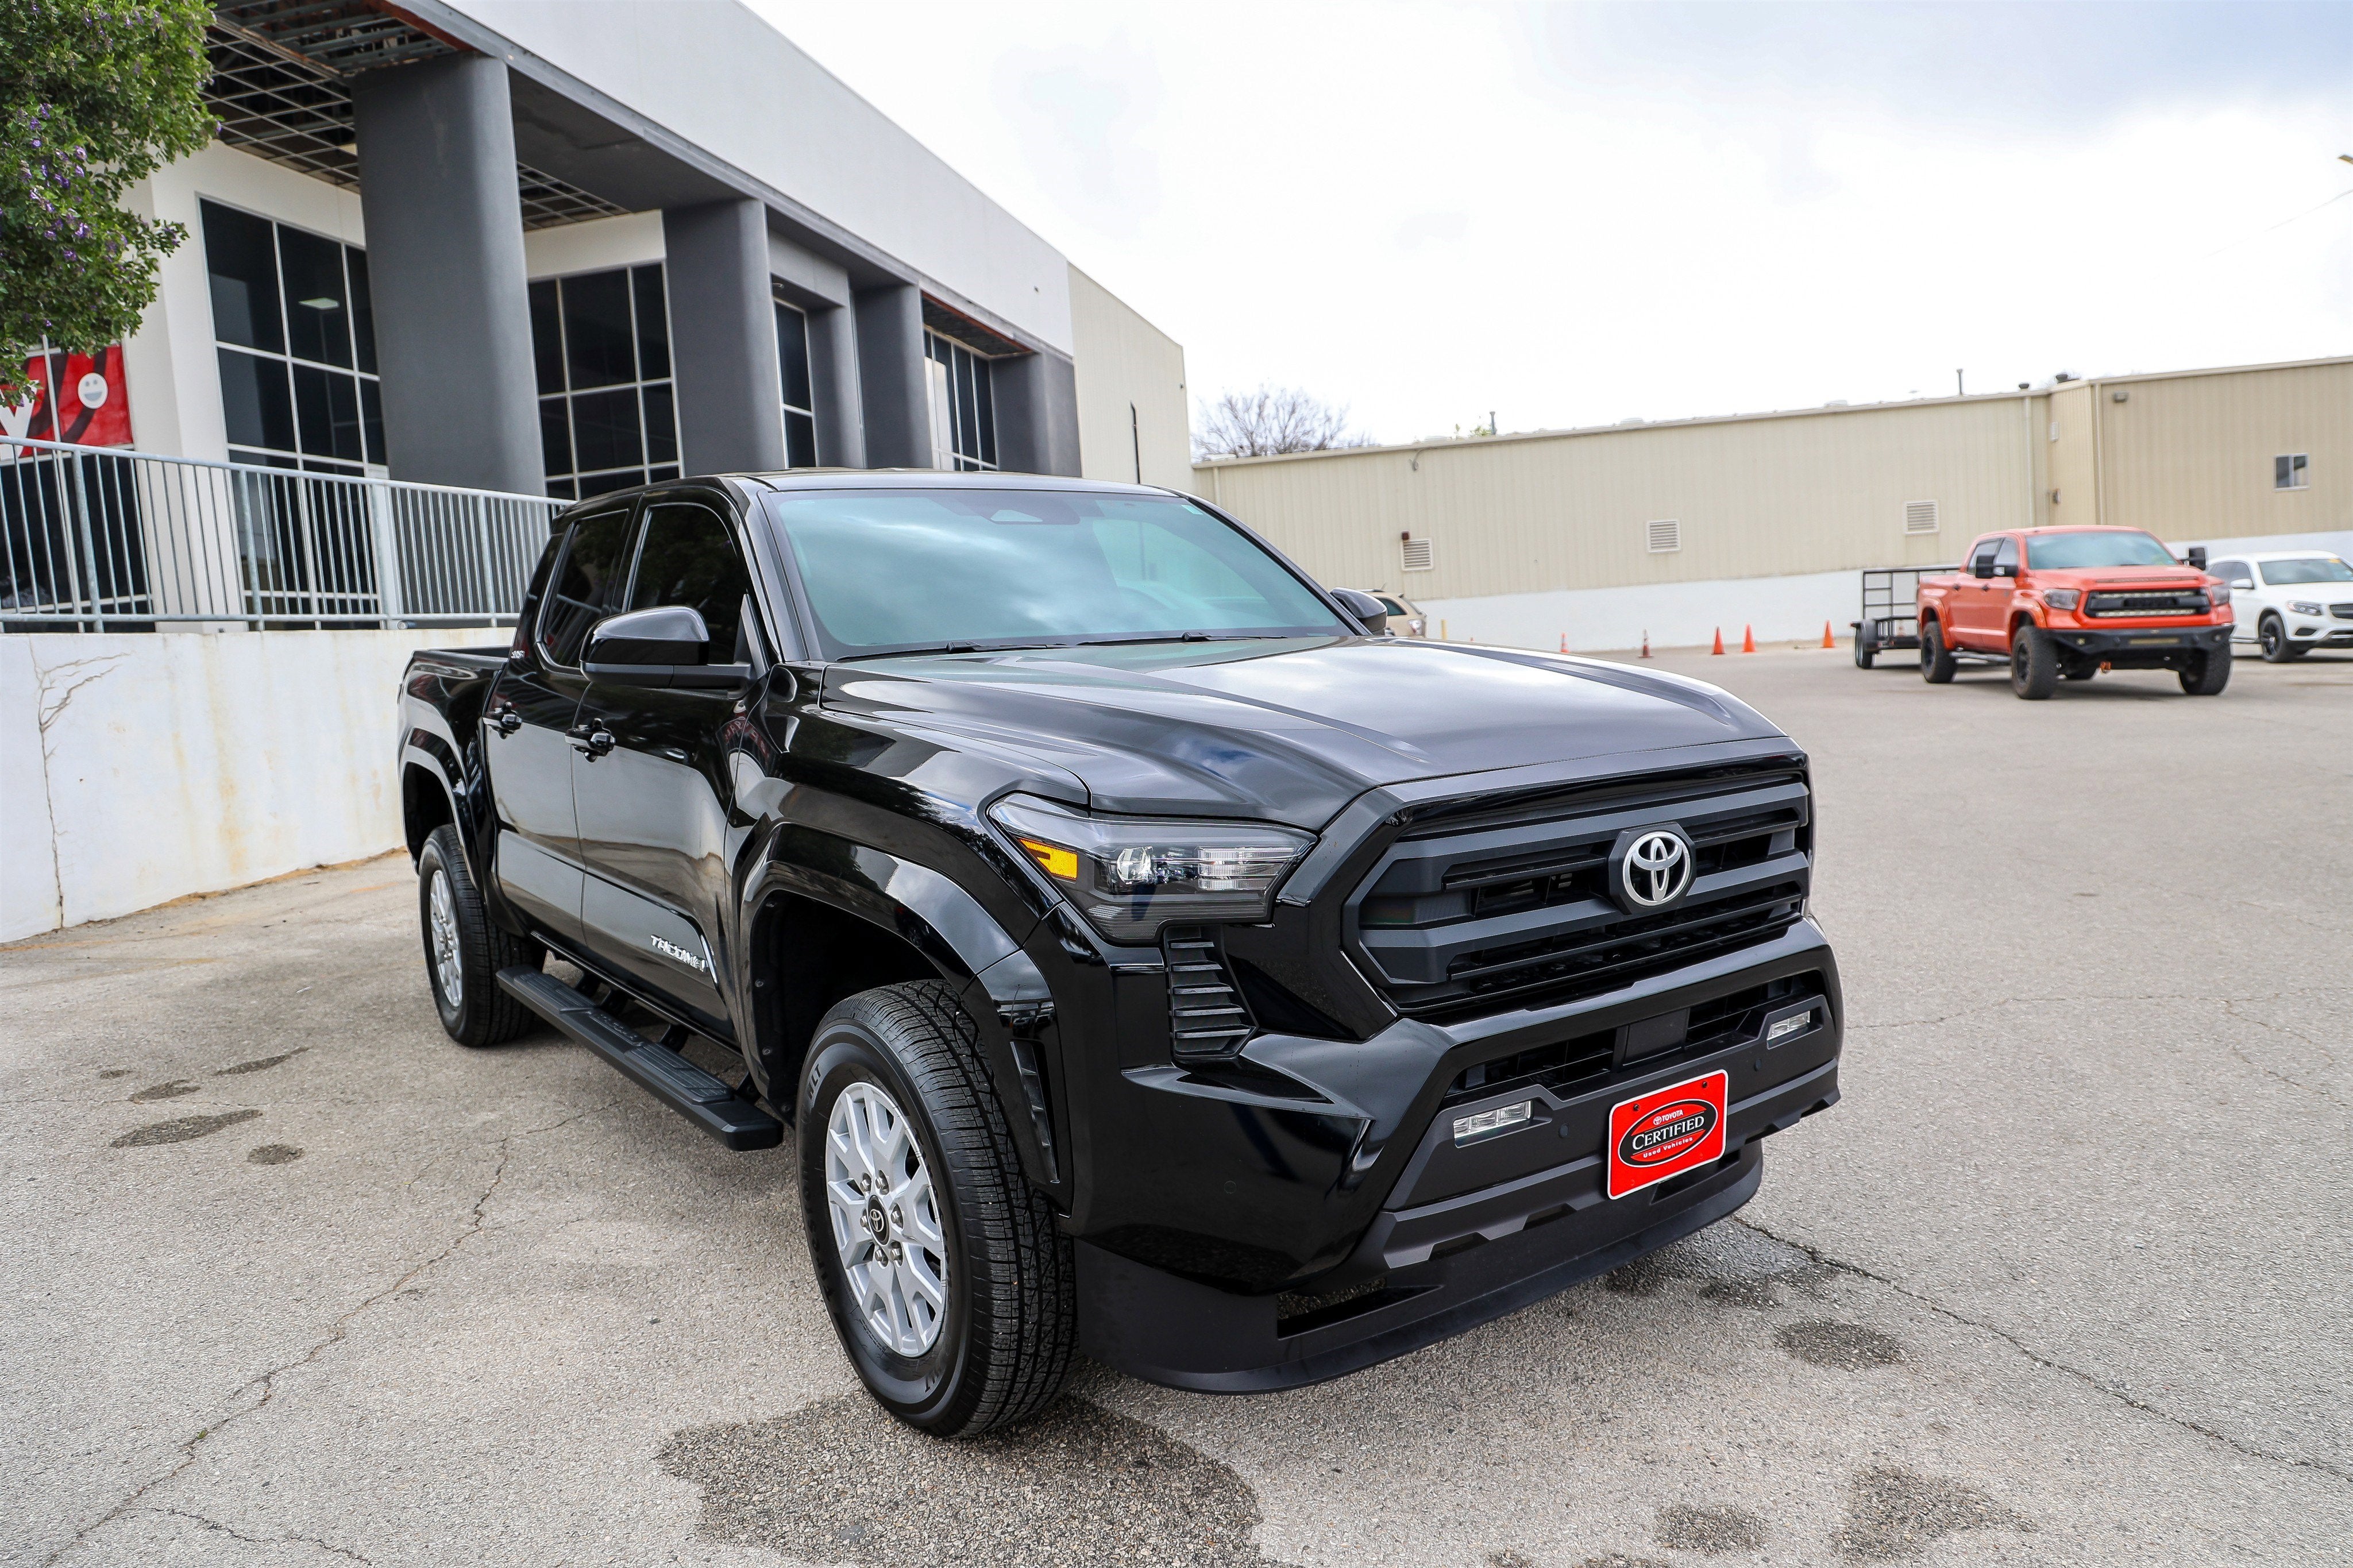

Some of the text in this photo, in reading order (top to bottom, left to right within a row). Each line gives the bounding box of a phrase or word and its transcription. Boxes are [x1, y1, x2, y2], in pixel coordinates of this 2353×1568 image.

[650, 934, 707, 973] TACOMA
[1662, 1109, 1684, 1122] TOYOTA
[1632, 1115, 1705, 1150] CERTIFIED
[1643, 1136, 1694, 1158] Used Vehicles
